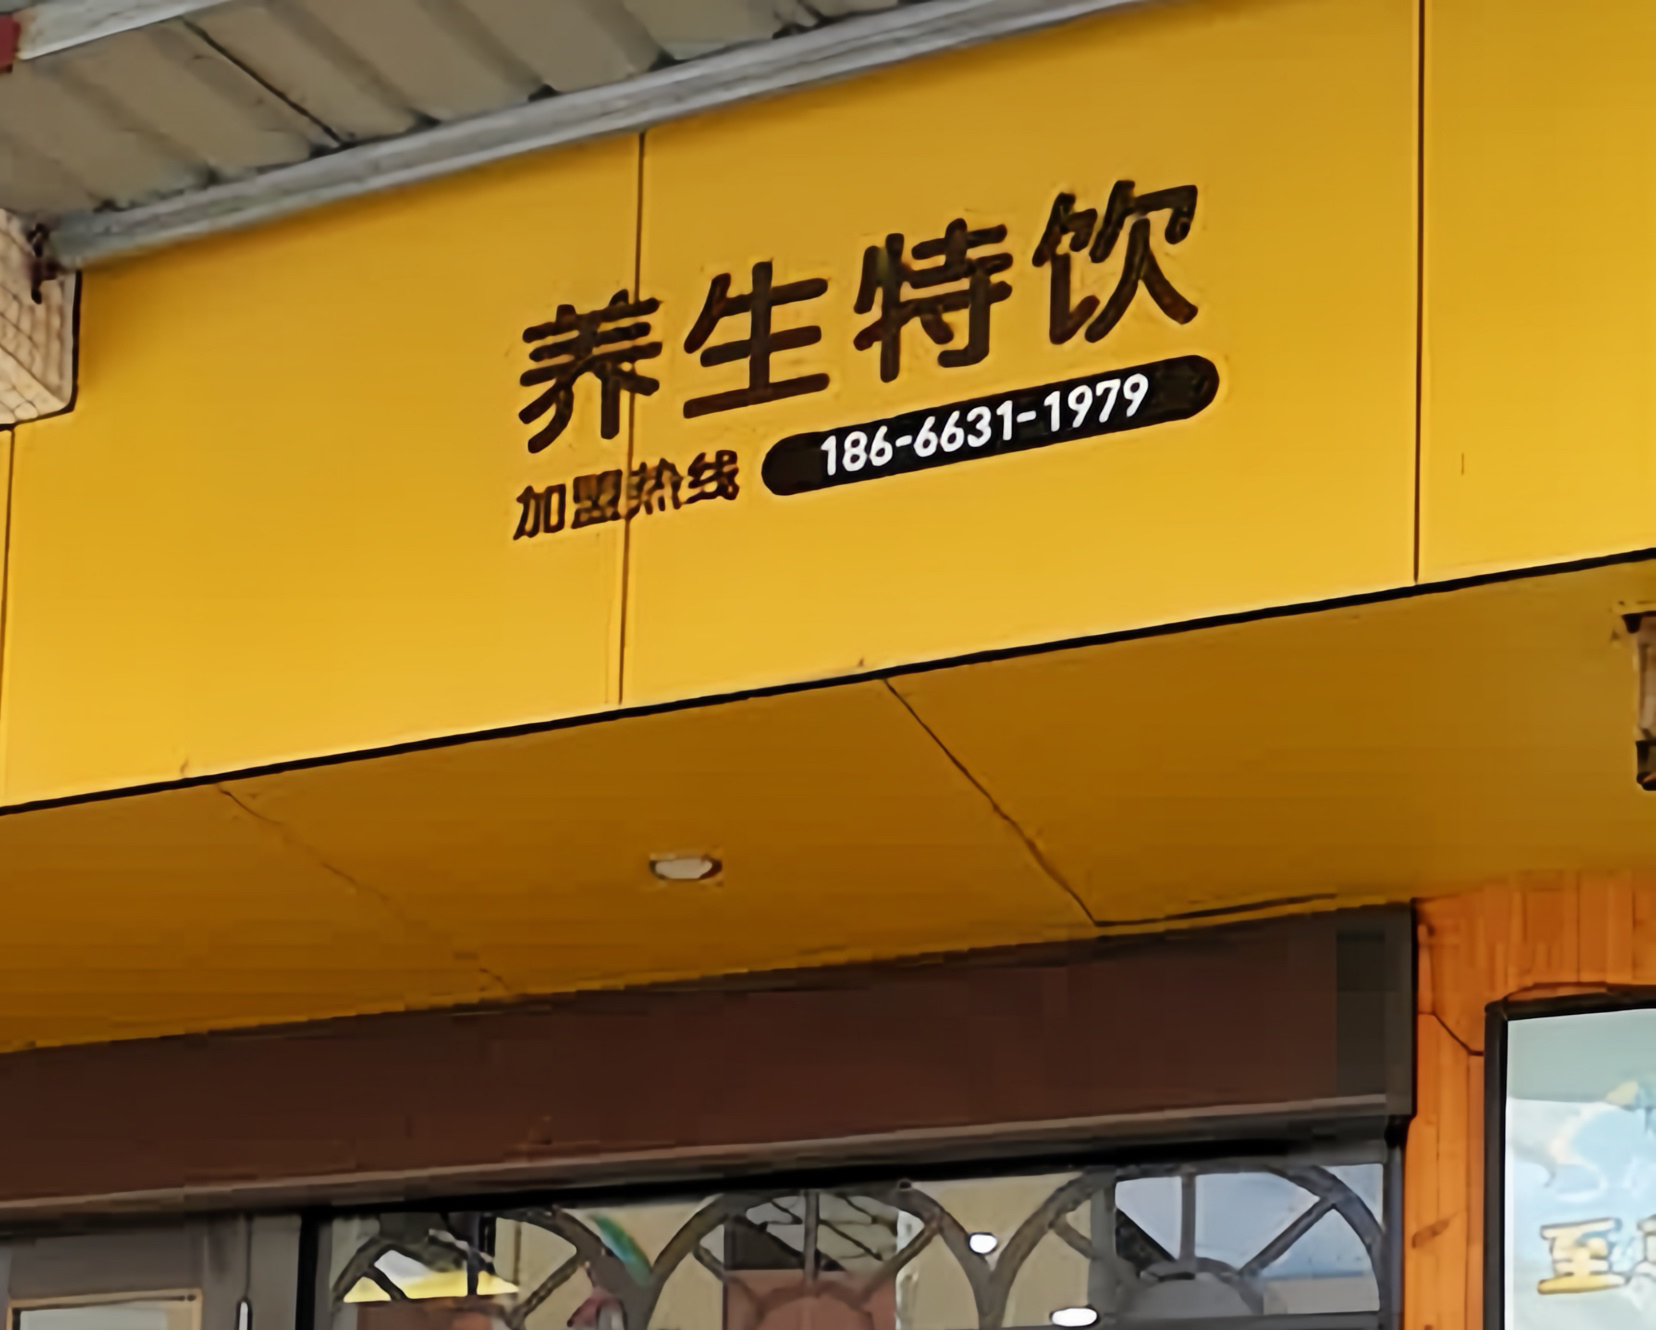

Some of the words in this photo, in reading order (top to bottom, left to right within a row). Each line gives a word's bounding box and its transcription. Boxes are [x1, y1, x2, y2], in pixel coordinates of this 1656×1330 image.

[518, 178, 1199, 454] 养生特饮
[819, 372, 1150, 477] 186-6631-1979
[512, 448, 740, 541] 加盟热线
